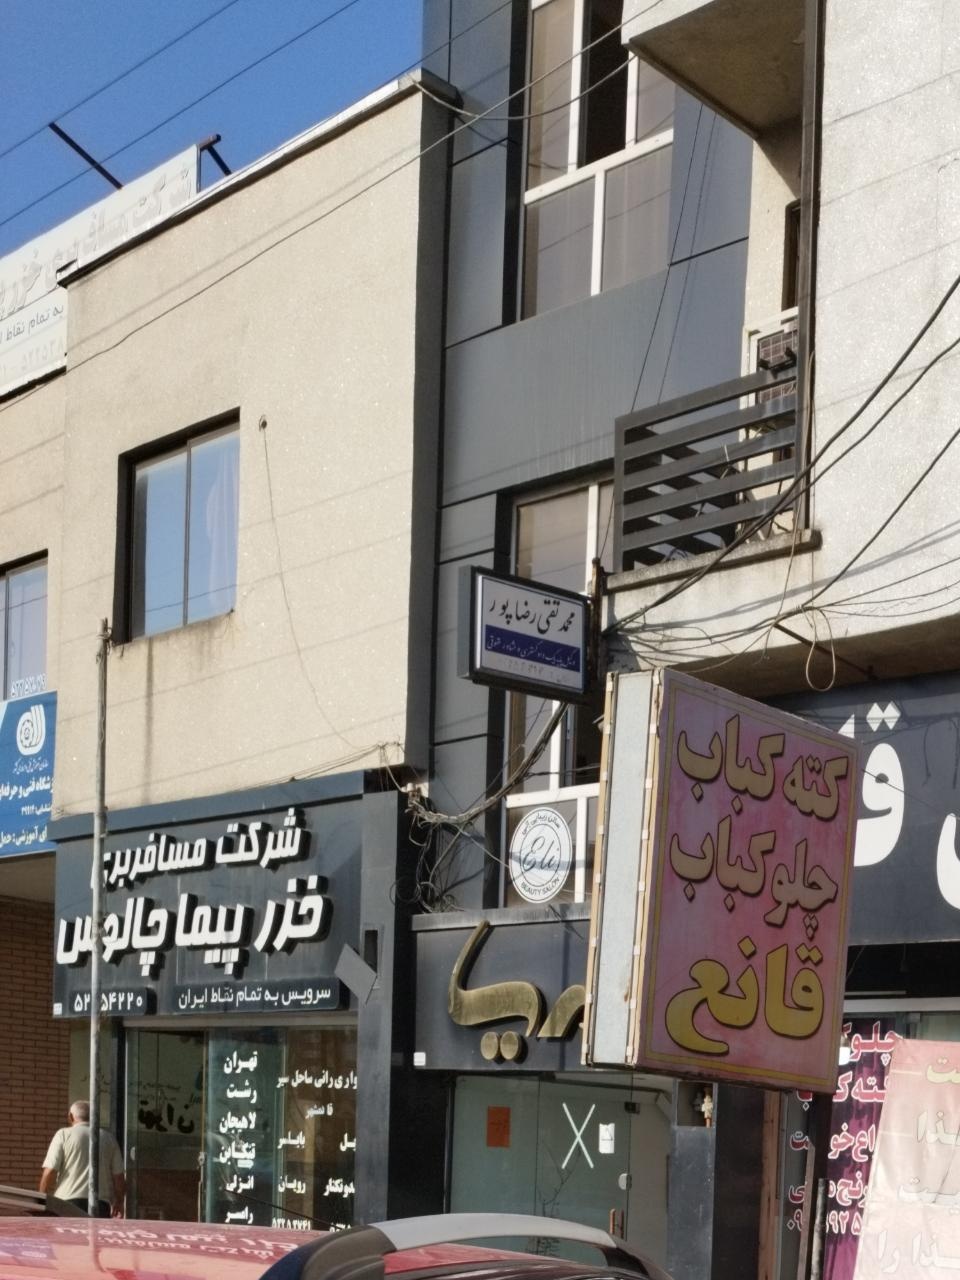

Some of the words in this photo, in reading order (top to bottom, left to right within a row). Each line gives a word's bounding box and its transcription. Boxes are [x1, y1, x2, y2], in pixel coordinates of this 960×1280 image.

[677, 713, 785, 814] کباب
[783, 754, 849, 824] کته
[215, 807, 302, 869] شرکت
[90, 831, 207, 889] مسافربری
[254, 875, 325, 952] خزر
[56, 896, 169, 977] چالوس
[174, 893, 245, 975] پیما
[74, 992, 143, 1011] ۵۲۵۴۲۲۰
[178, 987, 208, 1009] ایران
[210, 986, 234, 1003] نقاط
[236, 985, 262, 1007] تمام
[264, 988, 279, 1006] به
[281, 987, 331, 1006] سرویس
[664, 936, 825, 1056] قانع
[223, 1051, 258, 1074] تهران
[227, 1080, 257, 1103] رشت
[219, 1111, 257, 1133] لاهیجان
[226, 1174, 254, 1193] انزلی
